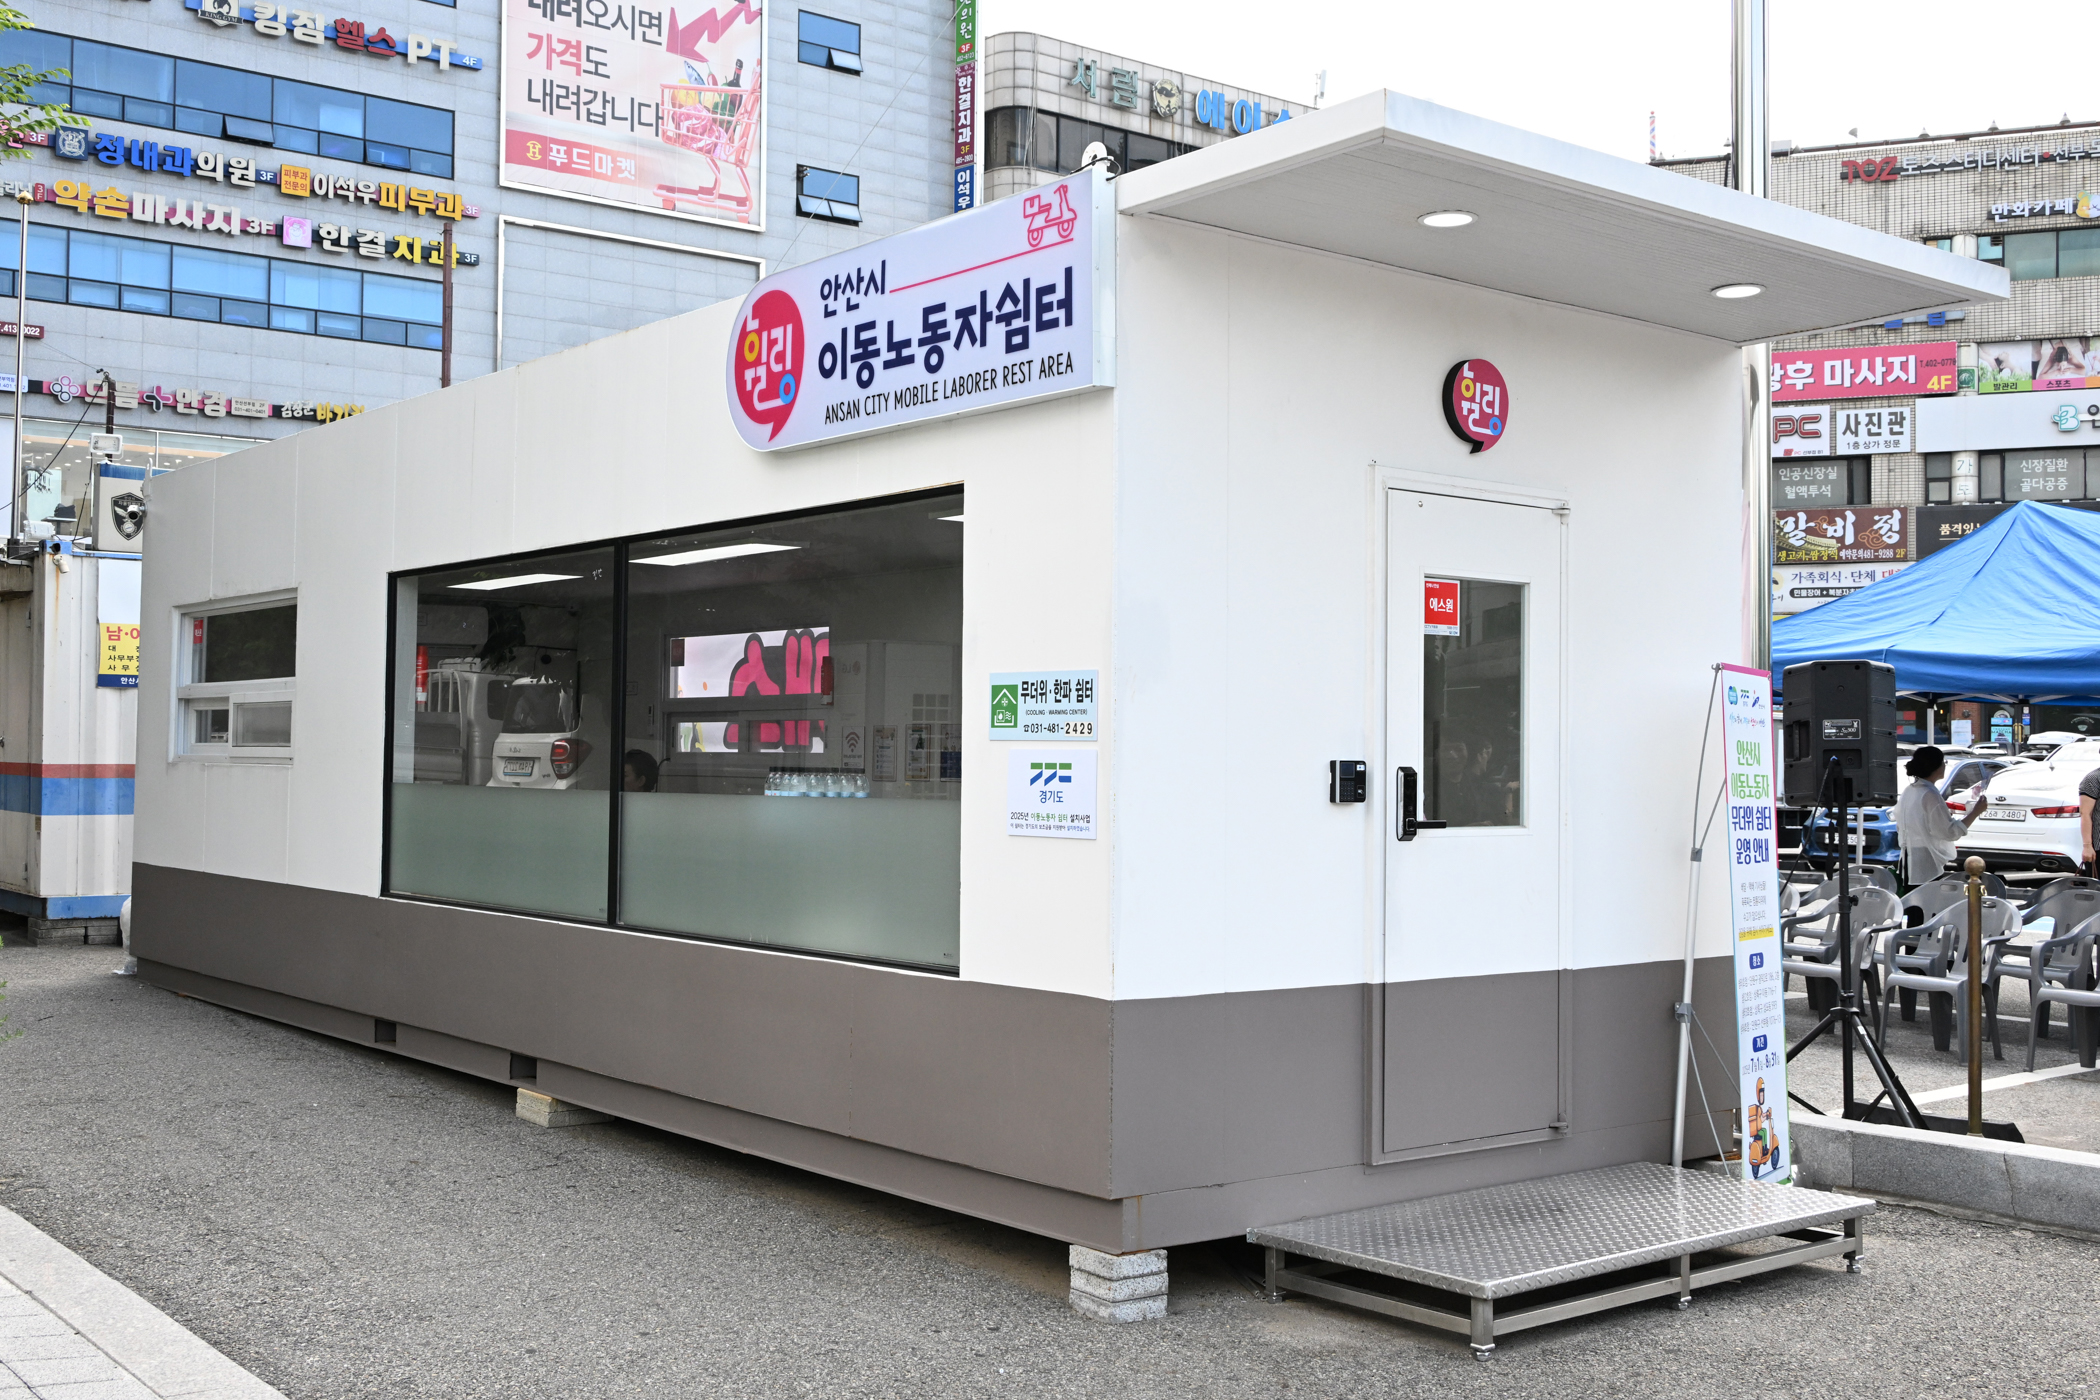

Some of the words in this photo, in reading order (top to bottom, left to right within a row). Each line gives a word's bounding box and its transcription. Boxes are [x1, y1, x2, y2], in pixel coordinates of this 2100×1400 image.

[960, 0, 972, 40] 의원
[254, 1, 326, 45] 킹짐
[334, 18, 396, 57] 헬스
[408, 33, 458, 70] PT
[462, 56, 478, 66] 4F
[526, 32, 610, 79] 가격도
[961, 44, 970, 53] 3F
[1068, 58, 1138, 110] 서림
[527, 78, 664, 138] 내려갑니다
[958, 76, 972, 144] 한결치과
[30, 132, 46, 142] 3F
[960, 144, 970, 154] 3F
[95, 132, 256, 188] 정내과의원
[260, 171, 274, 181] 3F
[548, 144, 636, 180] 푸드마켓
[1841, 156, 1898, 184] TOZ
[284, 169, 308, 181] 피부과
[284, 180, 308, 192] 전문의
[958, 170, 970, 209] 이석우
[466, 205, 478, 215] 3F
[1992, 198, 2074, 222] 만화카페
[246, 216, 274, 234] 3F
[318, 222, 460, 269] 한결치과
[464, 254, 477, 263] 3F
[820, 259, 886, 318] 안산시
[818, 265, 1073, 390] 이동노동자쉼터
[1824, 354, 1916, 388] 마사지
[1926, 374, 1952, 390] 4F
[824, 398, 860, 426] ANSAN
[864, 392, 890, 417] CITY
[894, 381, 939, 410] MOBILE
[943, 369, 998, 400] LABORER
[1002, 359, 1034, 388] REST
[1038, 352, 1074, 380] AREA
[1993, 382, 2018, 391] 발관리
[2046, 380, 2072, 388] 스포츠
[176, 388, 226, 418] 안경
[1842, 410, 1906, 438] 사진관
[1846, 442, 1860, 450] 1층
[1862, 440, 1880, 450] 상가
[1884, 440, 1901, 448] 정문
[1778, 466, 1838, 481] 인공신장실
[2020, 458, 2068, 473] 신장질환
[1784, 484, 1832, 499] 혈액투석
[2020, 477, 2068, 492] 골다공증
[1939, 522, 1980, 536] 품격있
[1896, 548, 1906, 558] 2F
[1429, 598, 1454, 613] 에스원
[1075, 678, 1094, 703] 쉼터
[1736, 740, 1761, 766] 안산시
[1039, 790, 1064, 803] 경기도
[1731, 772, 1770, 800] 이동노동자
[1732, 806, 1754, 831] 무더위
[1755, 806, 1772, 831] 쉼터
[2002, 810, 2021, 818] 2480
[1736, 838, 1752, 865] 운영
[1753, 838, 1769, 864] 안내
